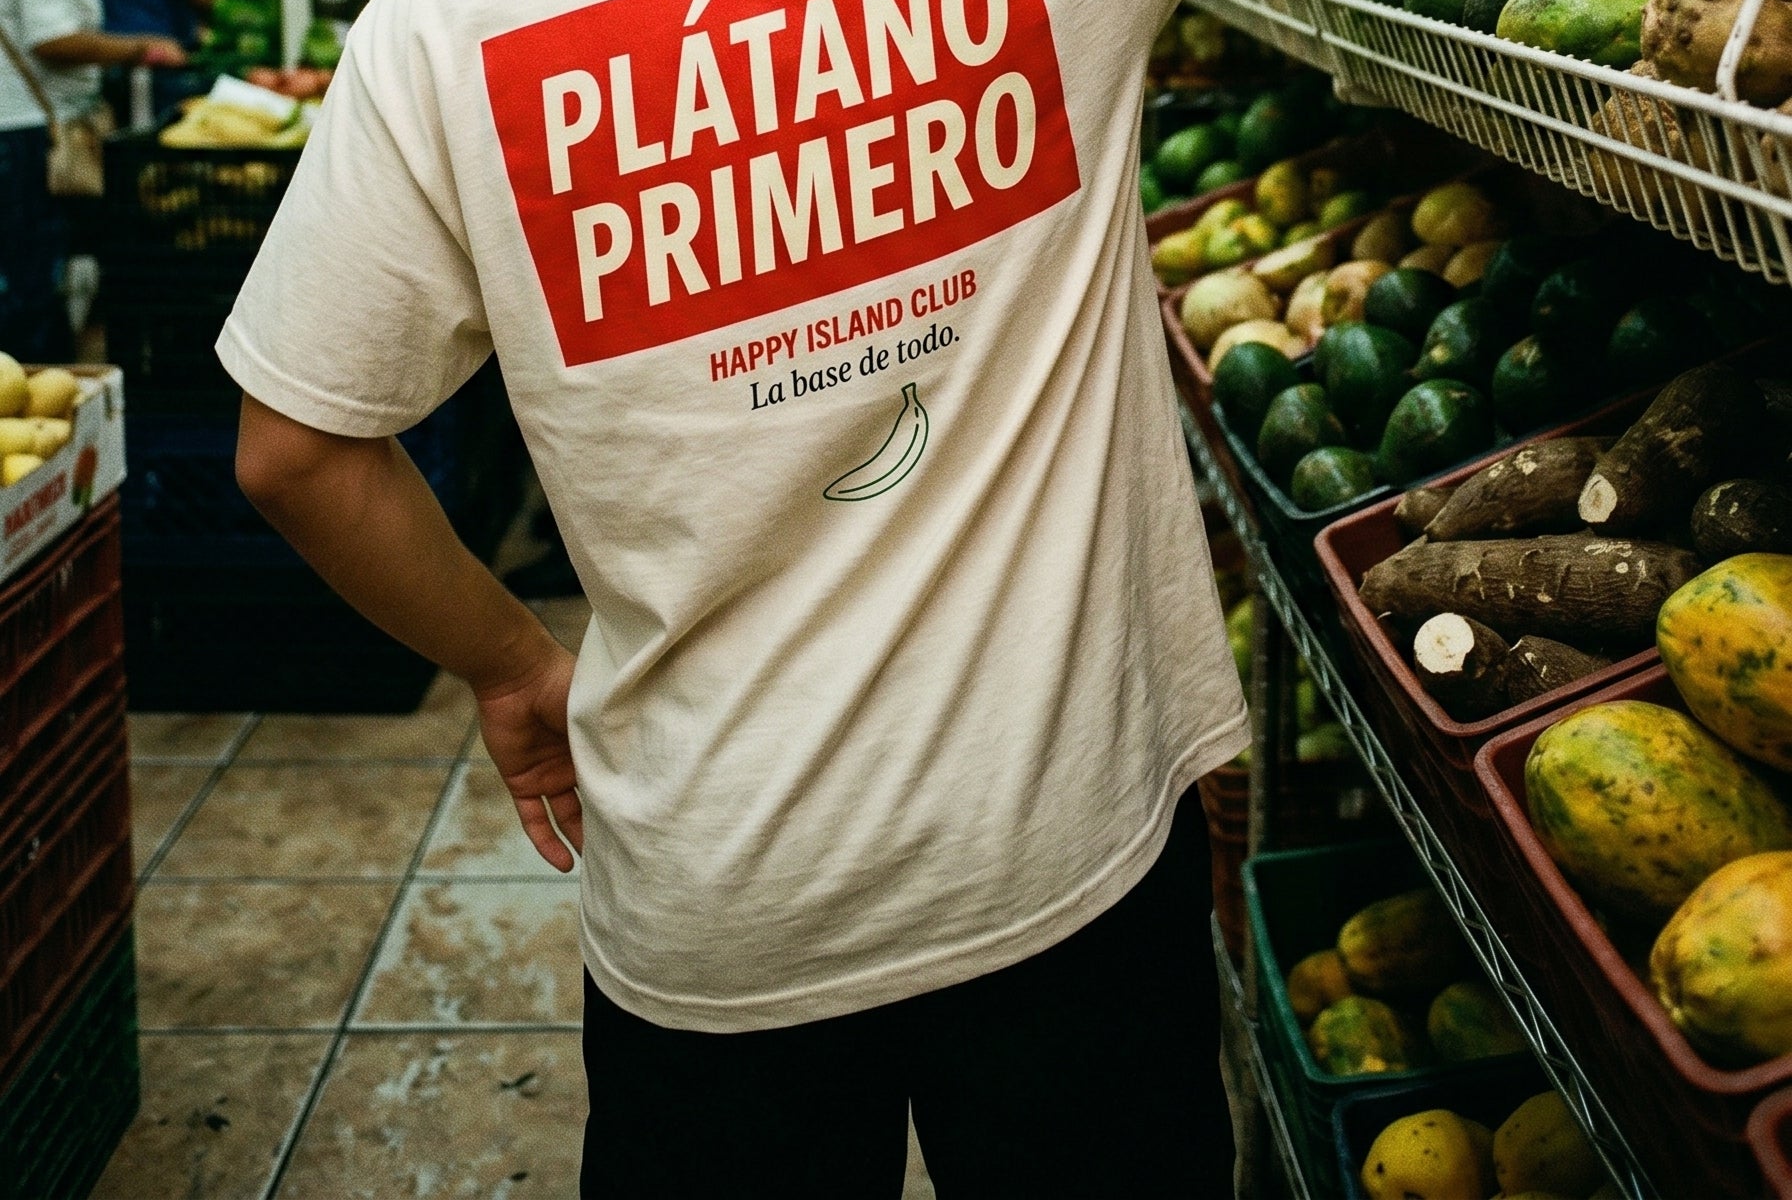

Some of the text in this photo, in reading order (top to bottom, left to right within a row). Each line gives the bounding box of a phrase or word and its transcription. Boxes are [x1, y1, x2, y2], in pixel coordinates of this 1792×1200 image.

[572, 72, 1037, 323] PRIMERO
[710, 269, 977, 381] HAPPY ISLAND CLUB
[750, 323, 960, 411] La base de todo.
